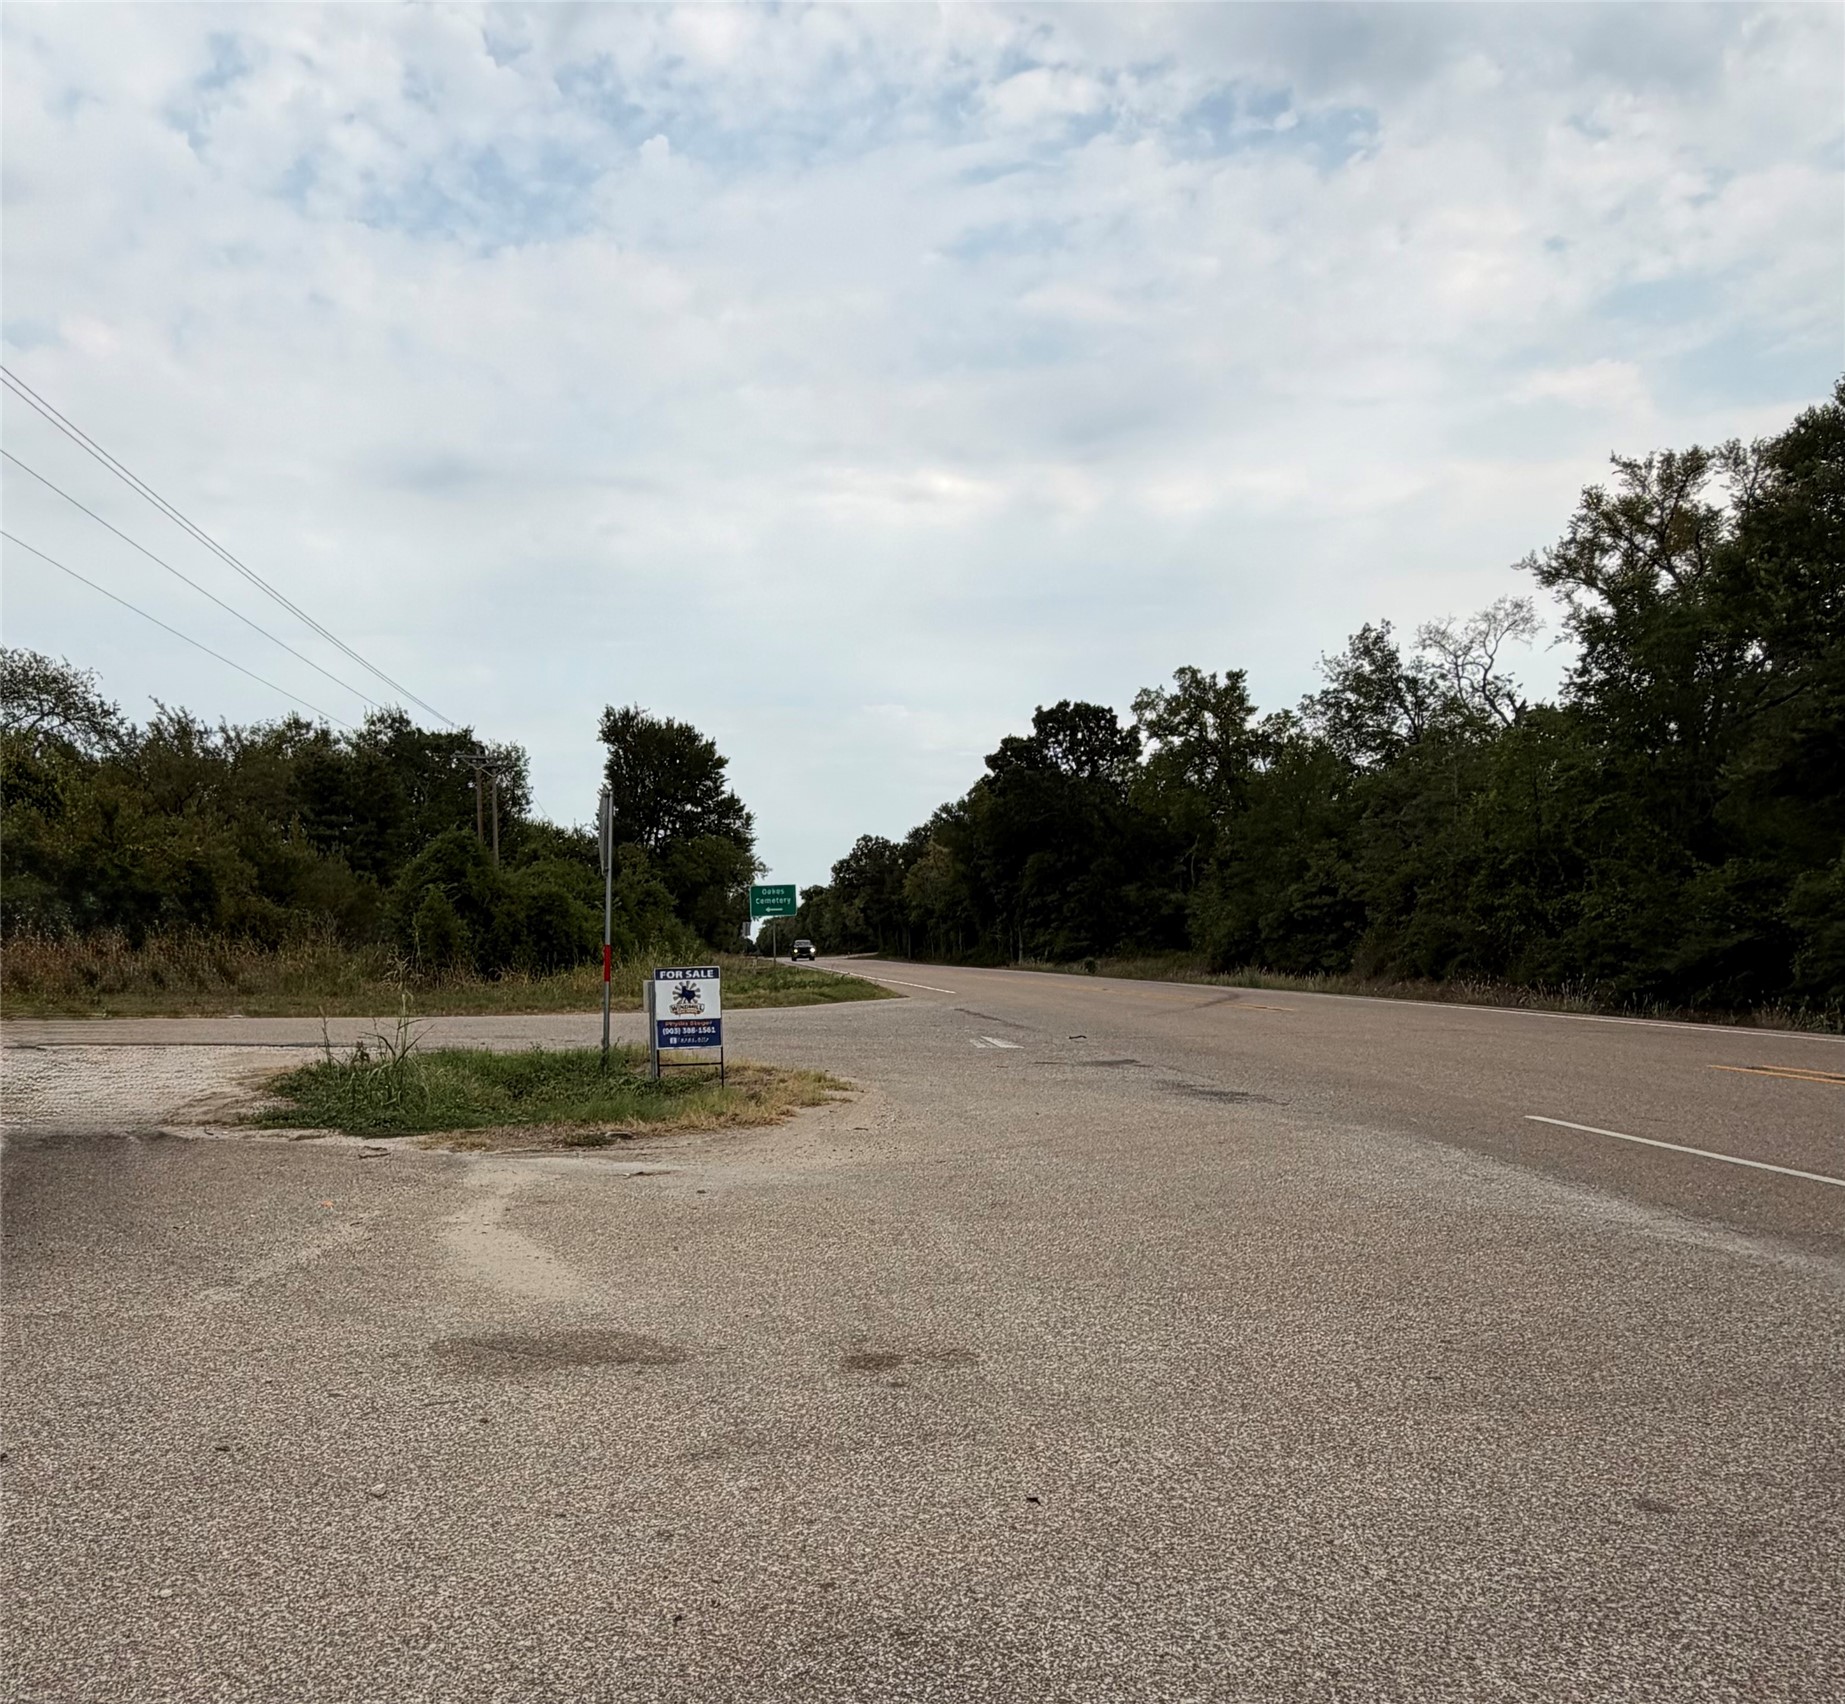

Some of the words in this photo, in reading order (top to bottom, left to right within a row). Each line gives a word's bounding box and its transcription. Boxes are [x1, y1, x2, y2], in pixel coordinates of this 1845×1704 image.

[755, 897, 791, 905] Cemetery
[660, 970, 683, 979] FOR
[685, 969, 714, 978] SALE
